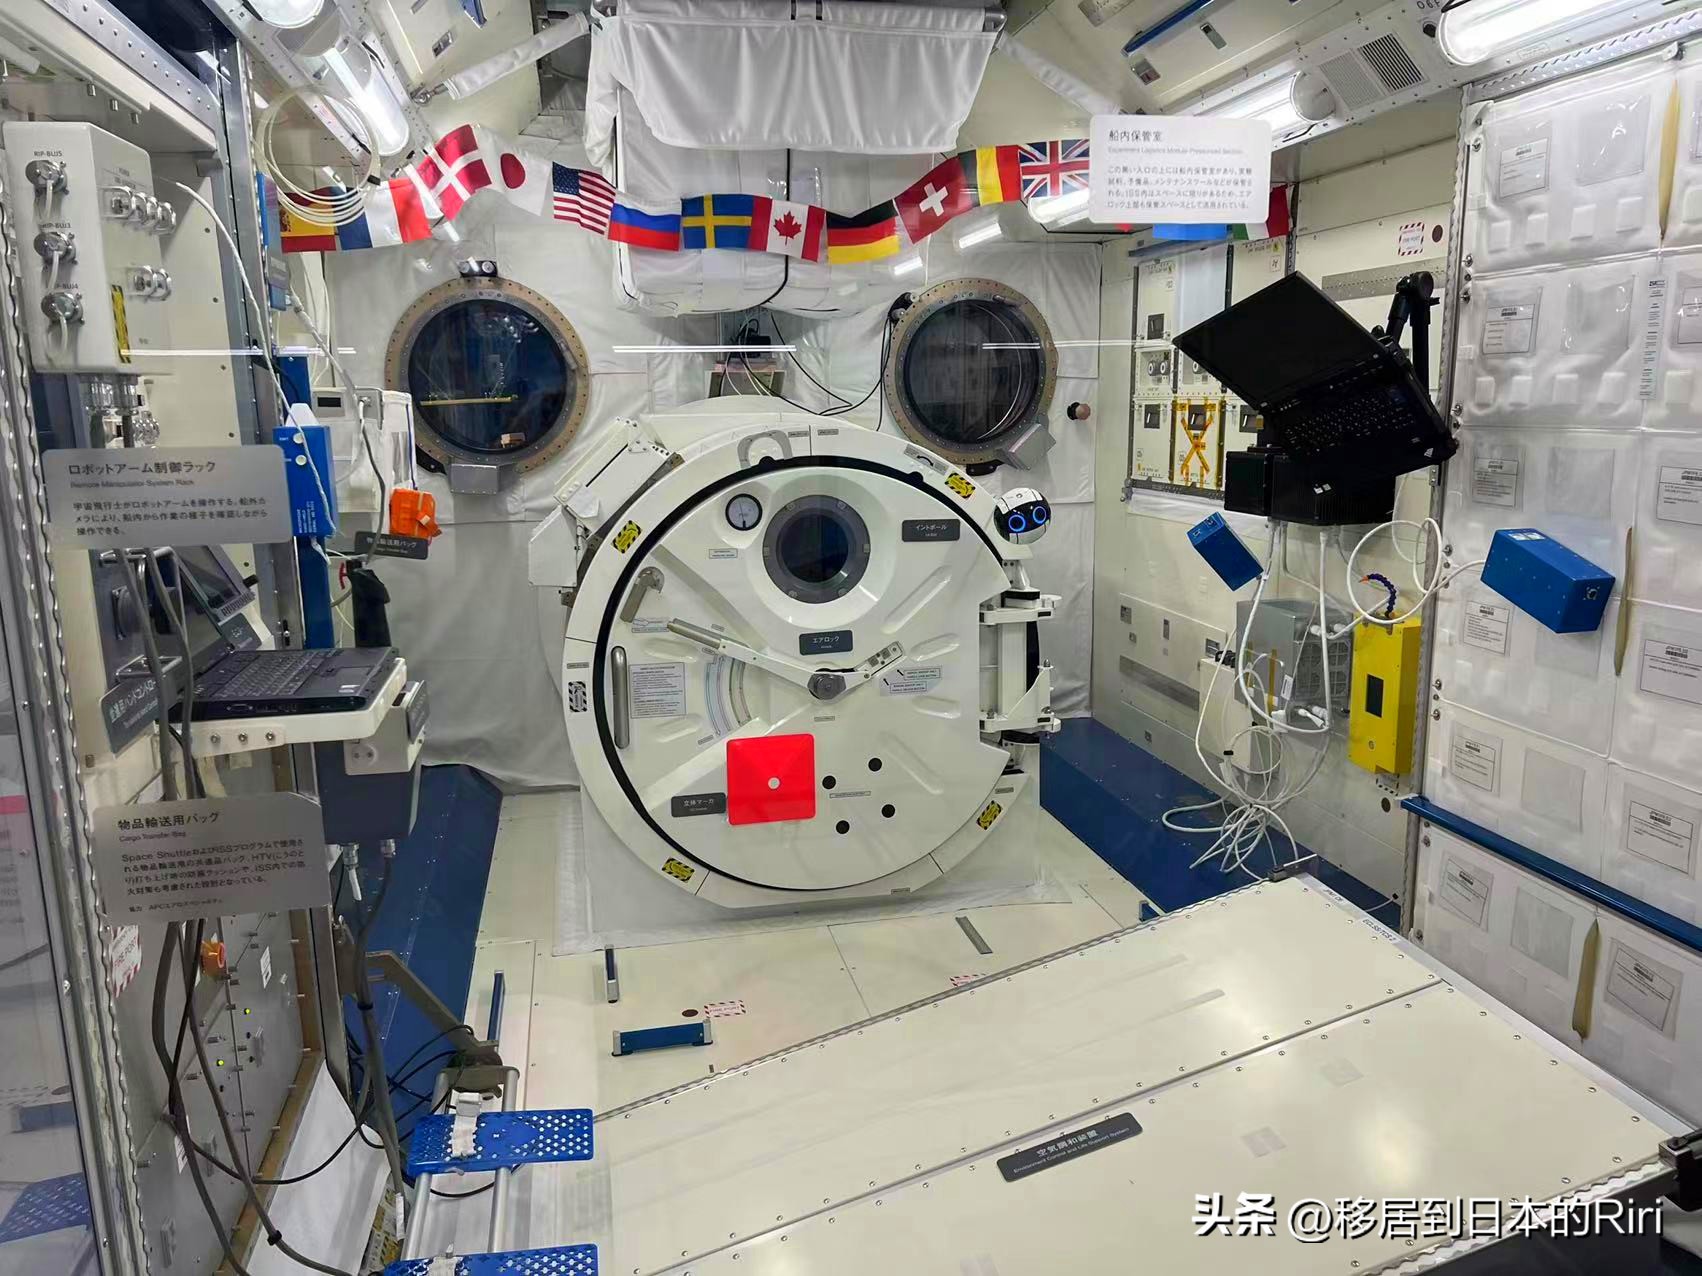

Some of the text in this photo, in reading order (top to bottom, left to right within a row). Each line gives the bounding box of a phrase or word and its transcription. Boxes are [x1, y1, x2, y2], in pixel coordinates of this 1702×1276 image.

[1109, 130, 1162, 142] 船内保管室
[68, 461, 216, 475] ロボットアーム制御ラック
[813, 636, 840, 644] エアロック
[118, 812, 220, 831] 物品輸送用バッグ
[122, 852, 153, 863] Space
